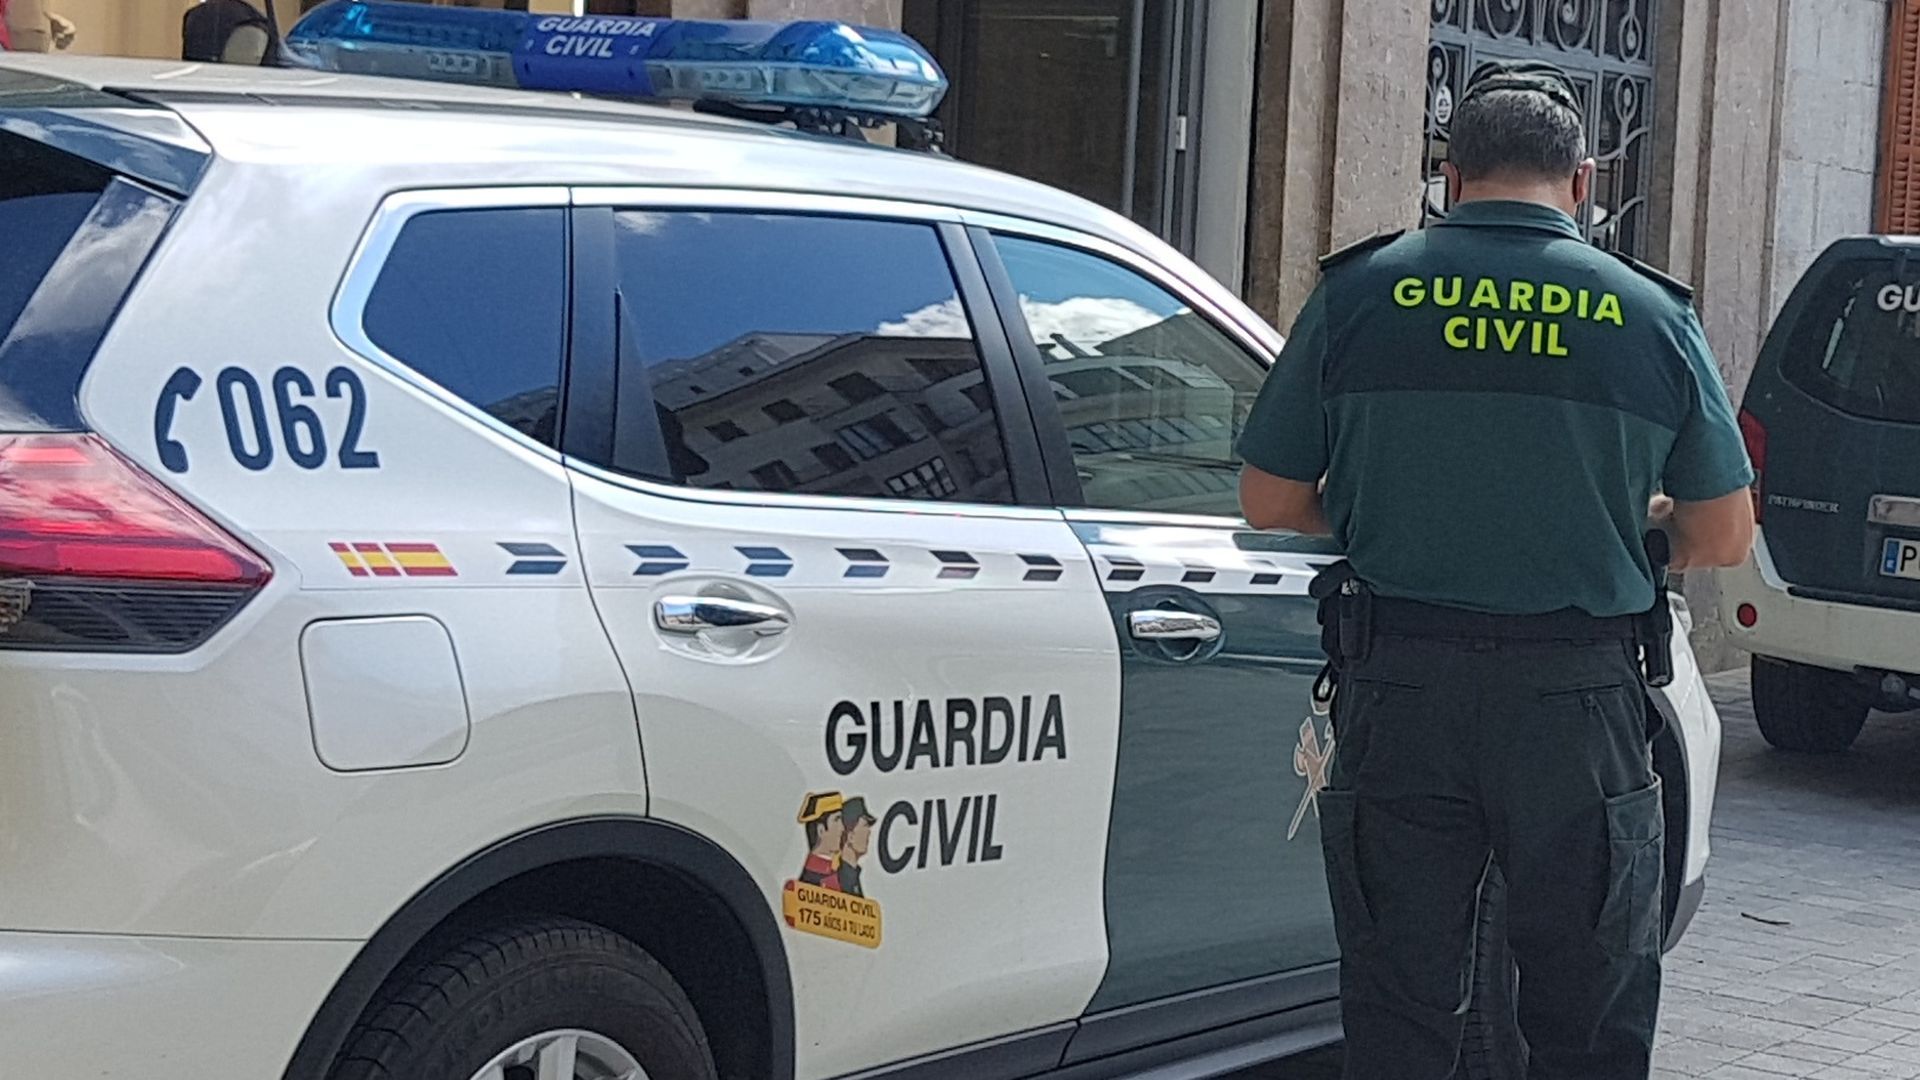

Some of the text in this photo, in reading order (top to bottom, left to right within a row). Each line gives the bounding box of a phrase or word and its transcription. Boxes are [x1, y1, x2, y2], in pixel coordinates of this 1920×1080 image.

[537, 17, 657, 37] GUARDIA
[545, 35, 613, 58] CIVIL
[1394, 277, 1624, 326] GUARDIA
[1444, 316, 1568, 357] CIVIL
[216, 366, 381, 471] 062
[825, 694, 1066, 776] GUARDIA
[877, 794, 1003, 874] CIVIL
[797, 888, 877, 919] GUARDIA CIVIL
[799, 908, 821, 926] 175
